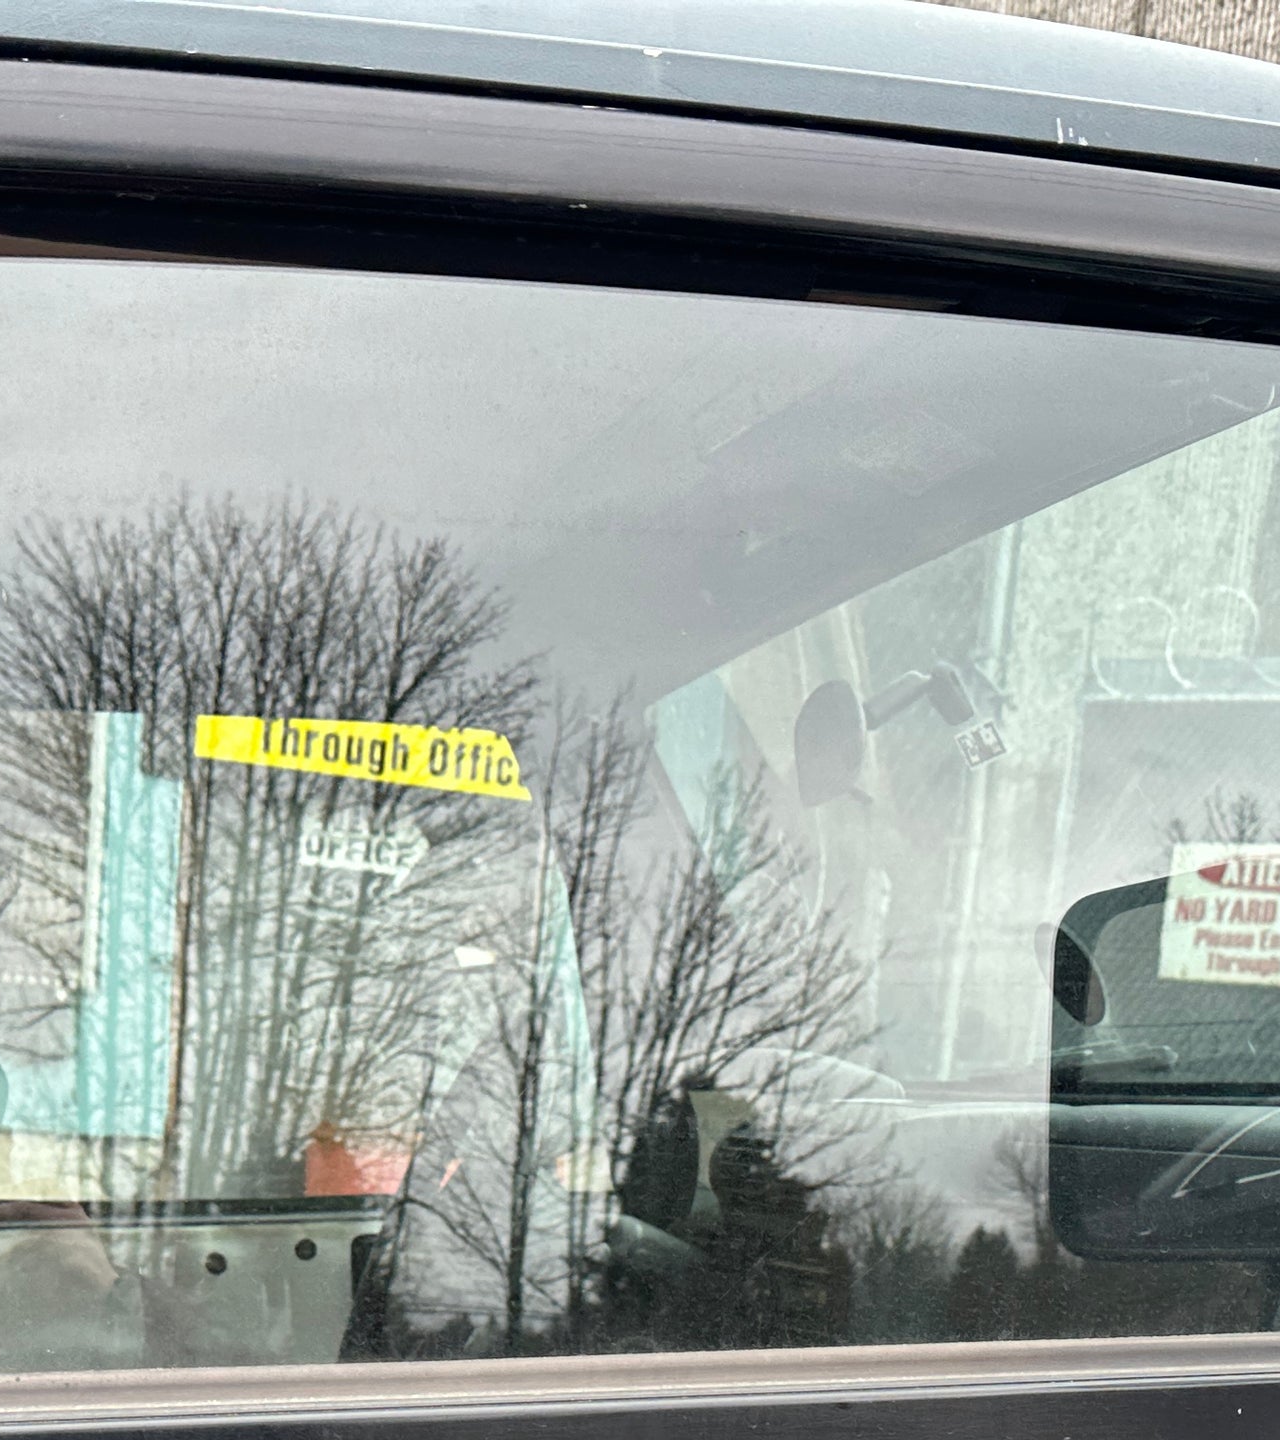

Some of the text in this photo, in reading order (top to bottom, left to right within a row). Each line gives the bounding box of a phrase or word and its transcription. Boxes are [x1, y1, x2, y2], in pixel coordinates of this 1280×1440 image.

[263, 718, 523, 788] Through Offic
[1174, 895, 1206, 922] NO
[1215, 898, 1277, 925] YARD
[1194, 928, 1255, 949] Please
[1207, 952, 1280, 977] Through
